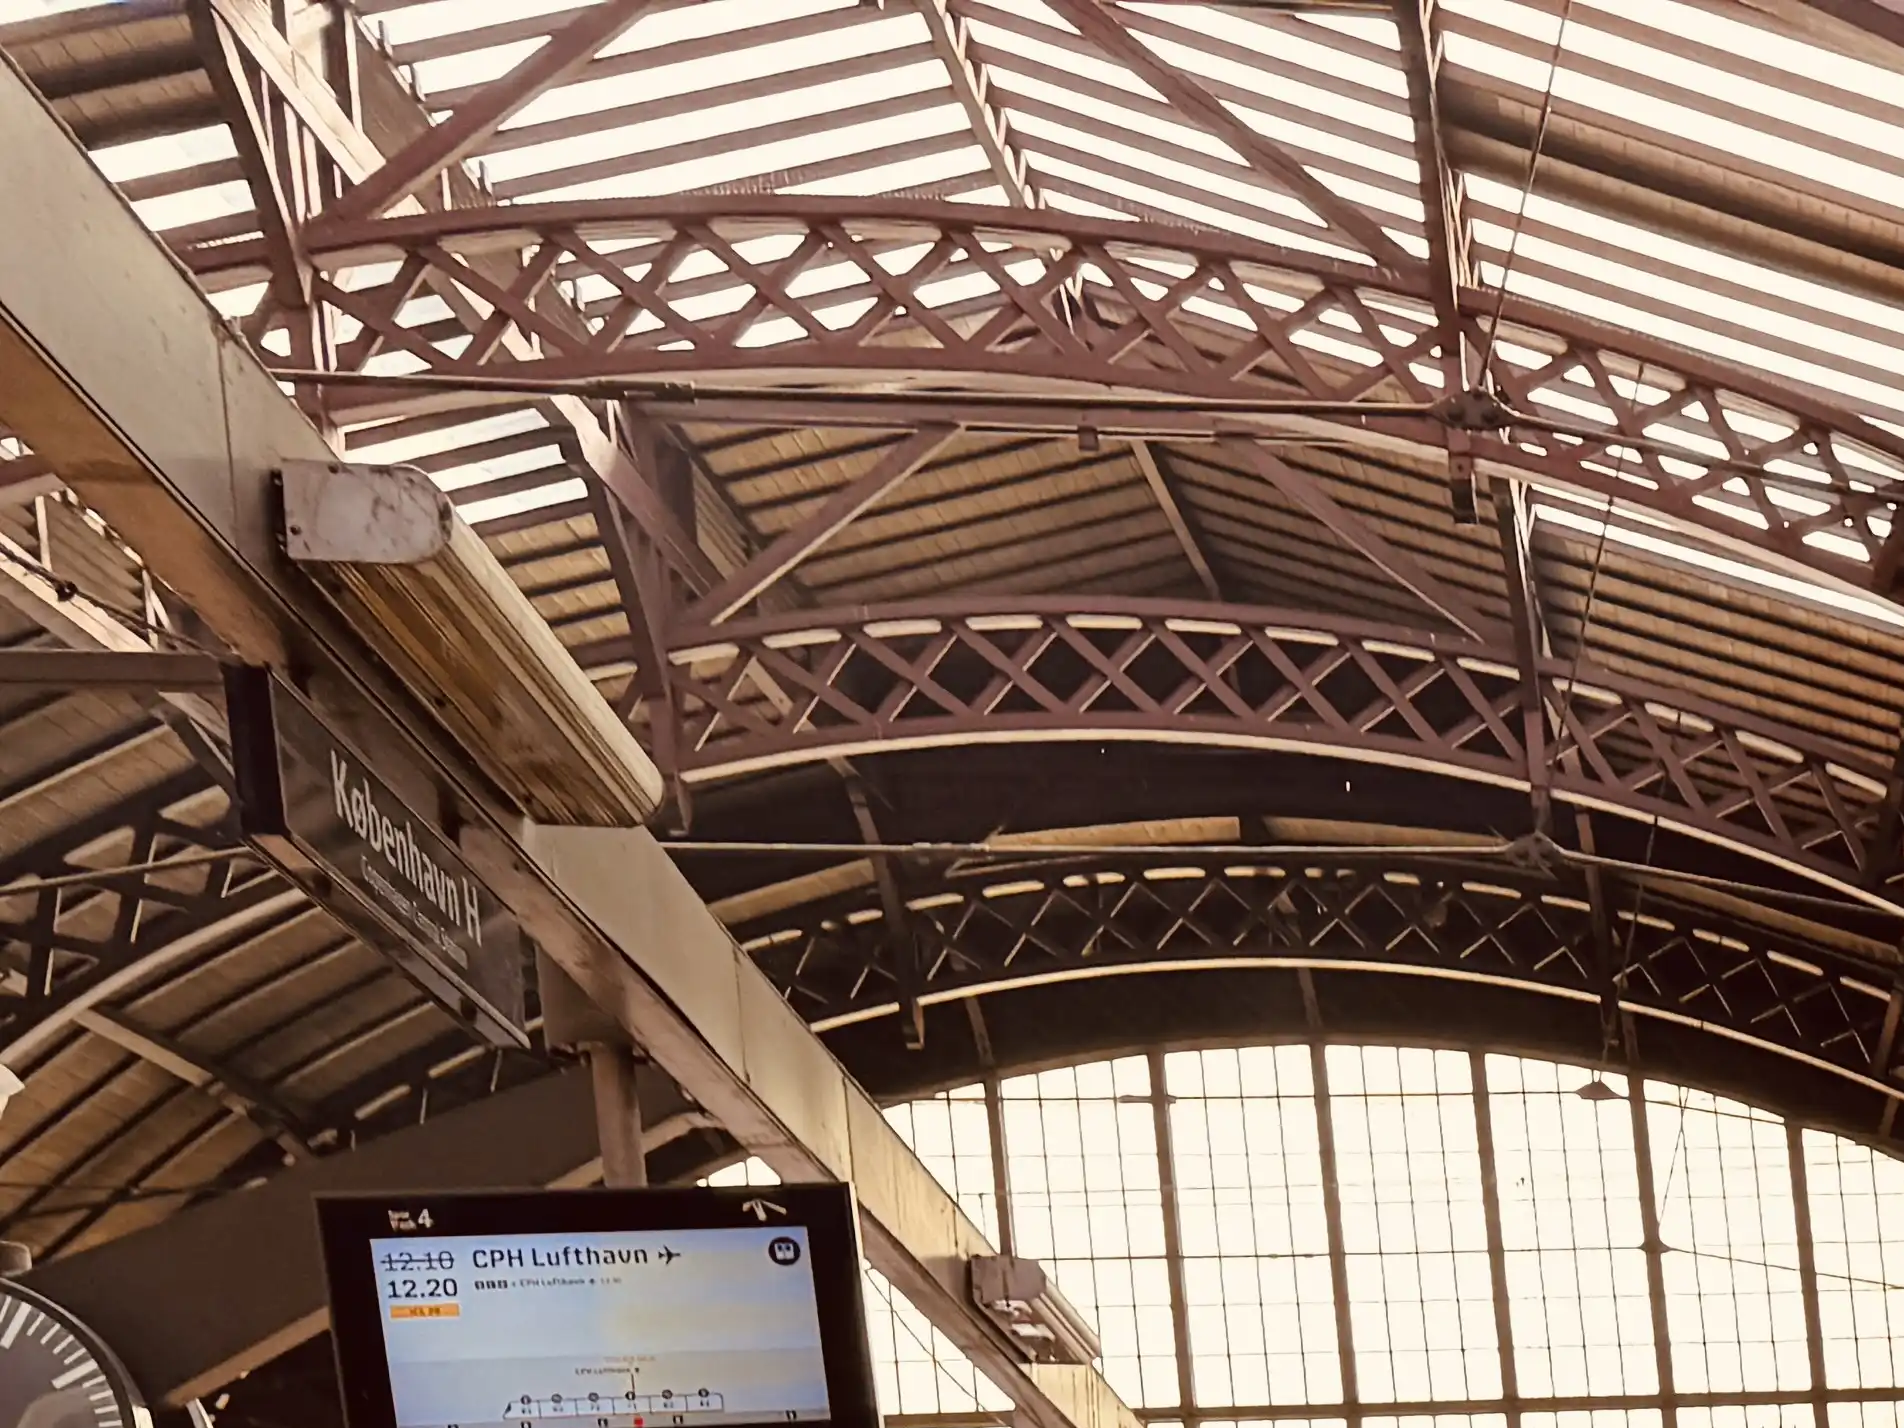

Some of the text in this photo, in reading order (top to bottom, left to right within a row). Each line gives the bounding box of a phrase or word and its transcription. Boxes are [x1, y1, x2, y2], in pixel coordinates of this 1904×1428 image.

[331, 748, 460, 926] København
[462, 876, 482, 948] H
[472, 1246, 648, 1269] CPH Lufthavn
[387, 1278, 458, 1299] 12.20
